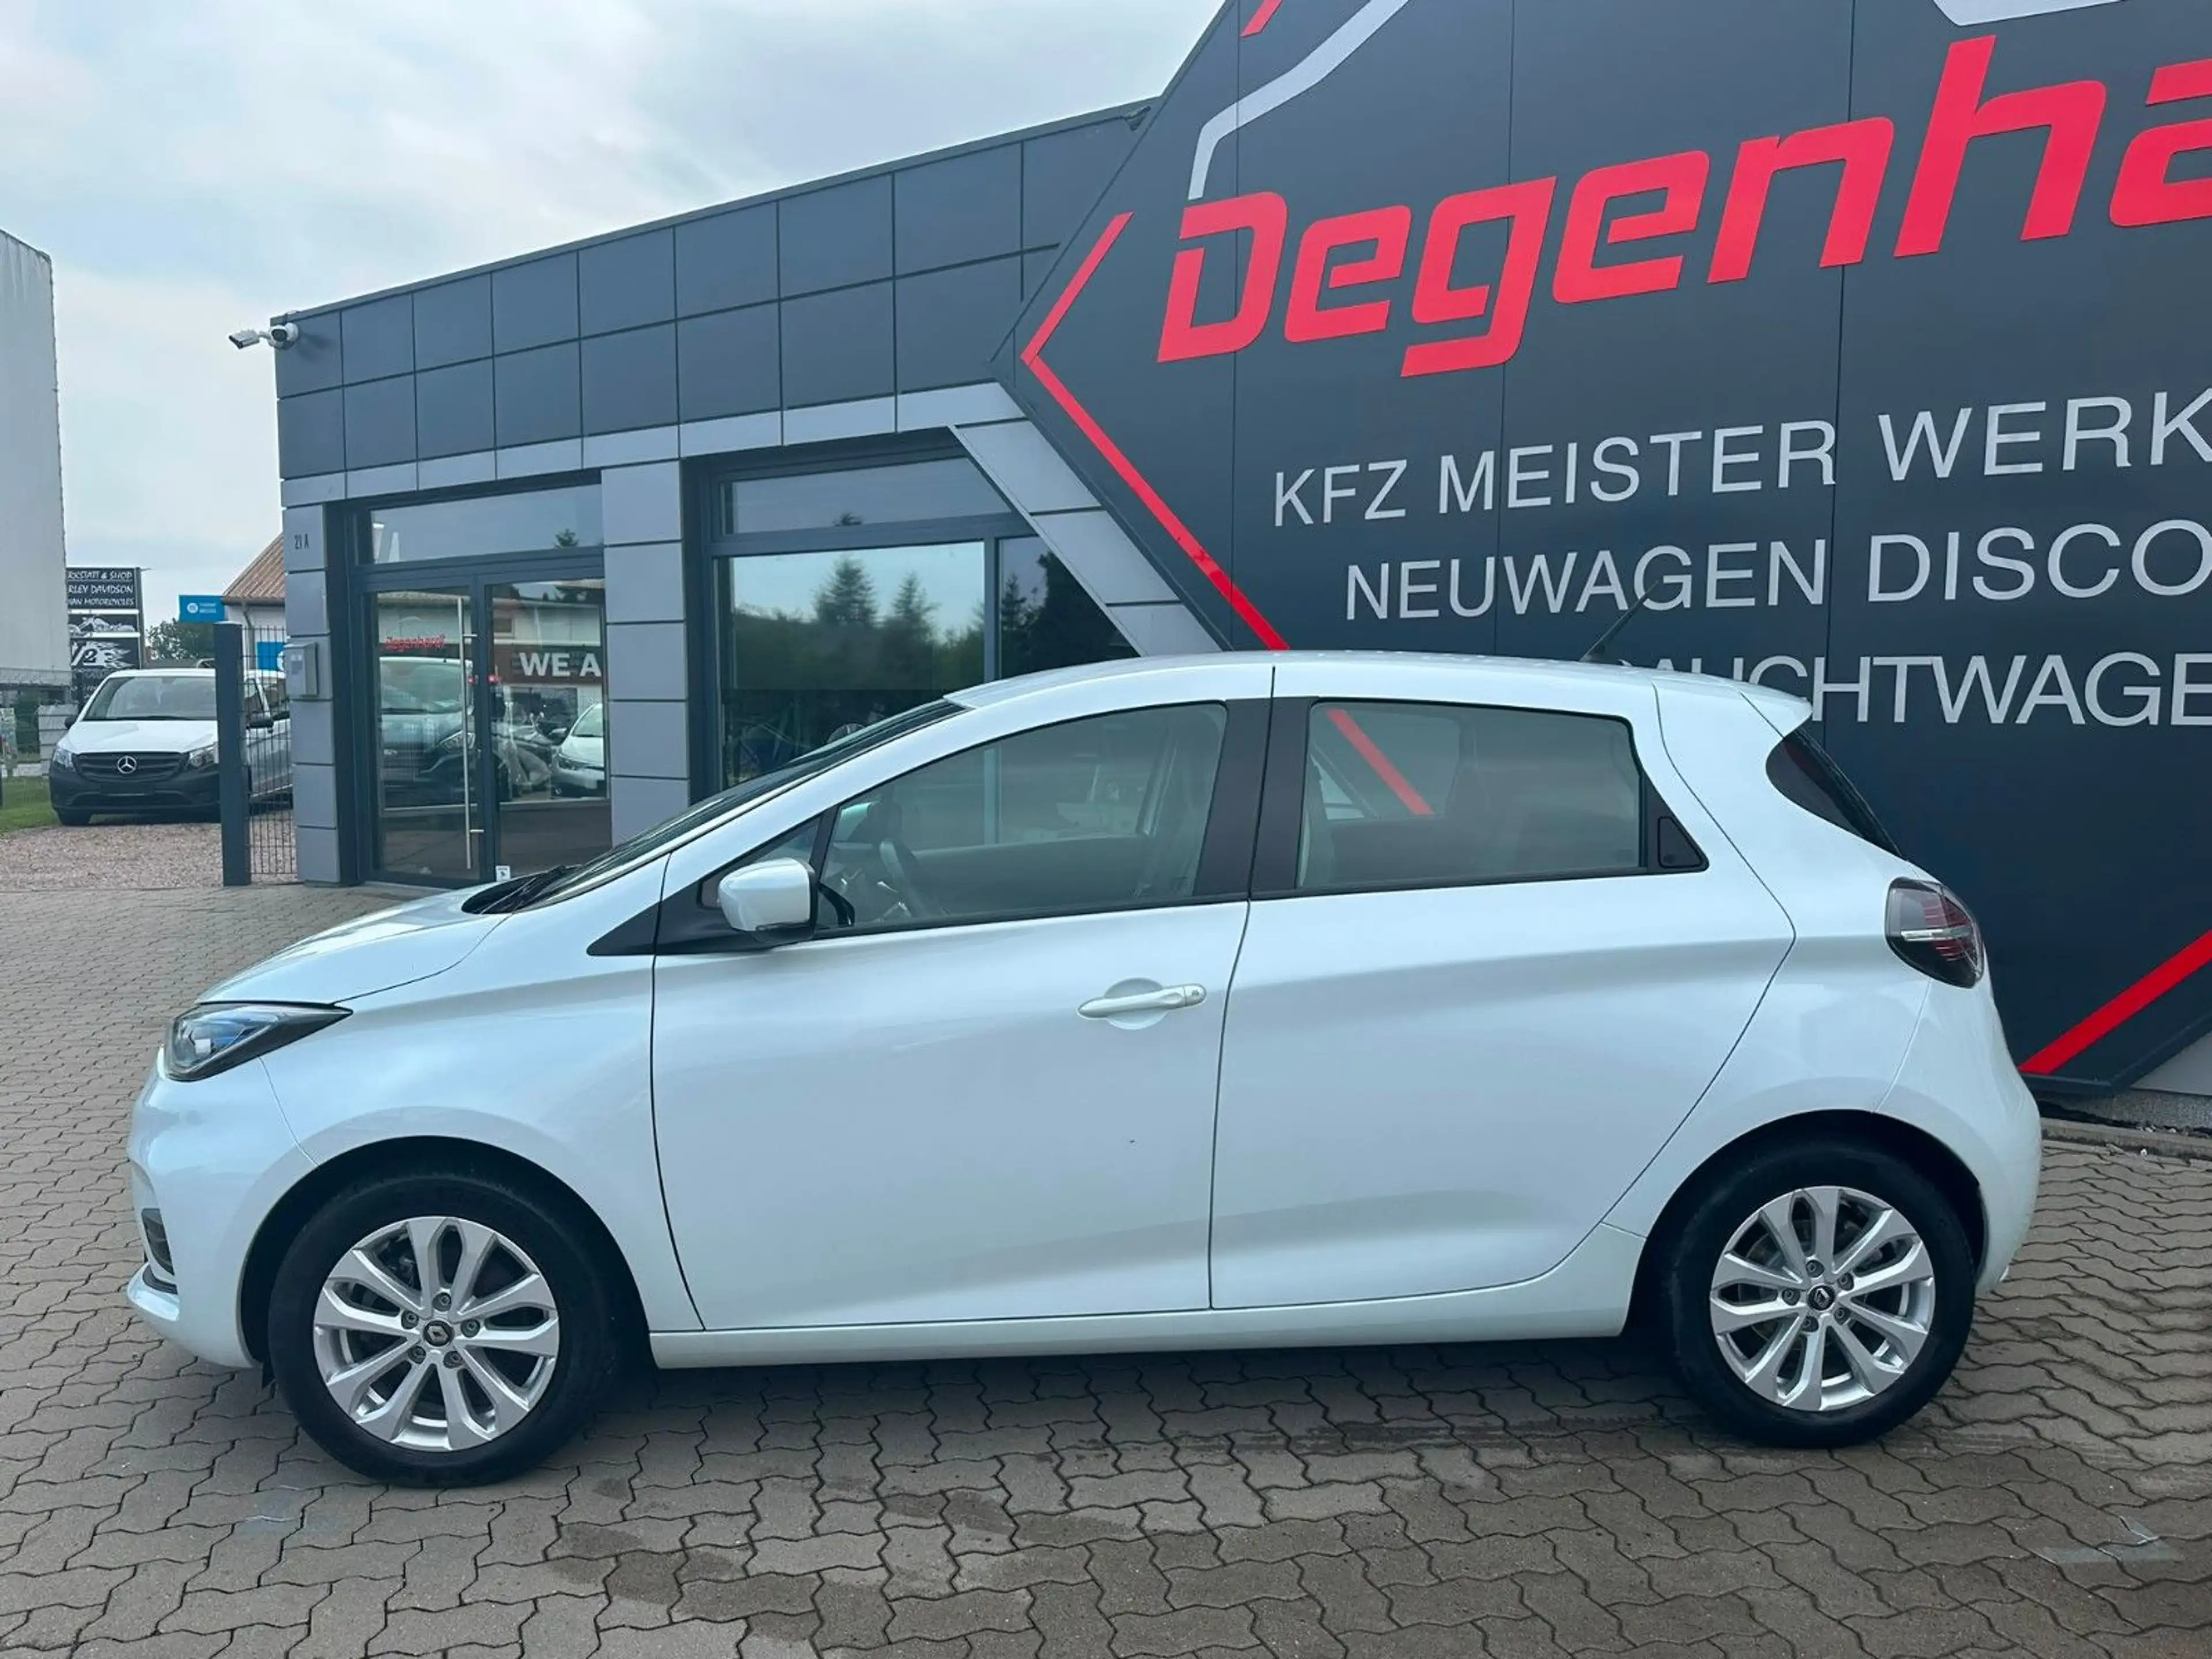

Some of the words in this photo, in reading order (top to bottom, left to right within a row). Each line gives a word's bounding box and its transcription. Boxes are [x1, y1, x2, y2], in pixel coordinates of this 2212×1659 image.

[1274, 460, 1407, 527] KFZ
[1439, 419, 1836, 514] MEISTER
[294, 534, 302, 550] 21
[304, 533, 309, 549] A
[109, 570, 133, 579] SHOP
[1346, 539, 1826, 620] NEUWAGEN
[1868, 519, 2212, 602] DISCO
[90, 584, 134, 594] DAVIDSON
[84, 597, 134, 606] MOTORCYCLES
[519, 652, 570, 677] WE
[579, 653, 602, 677] A
